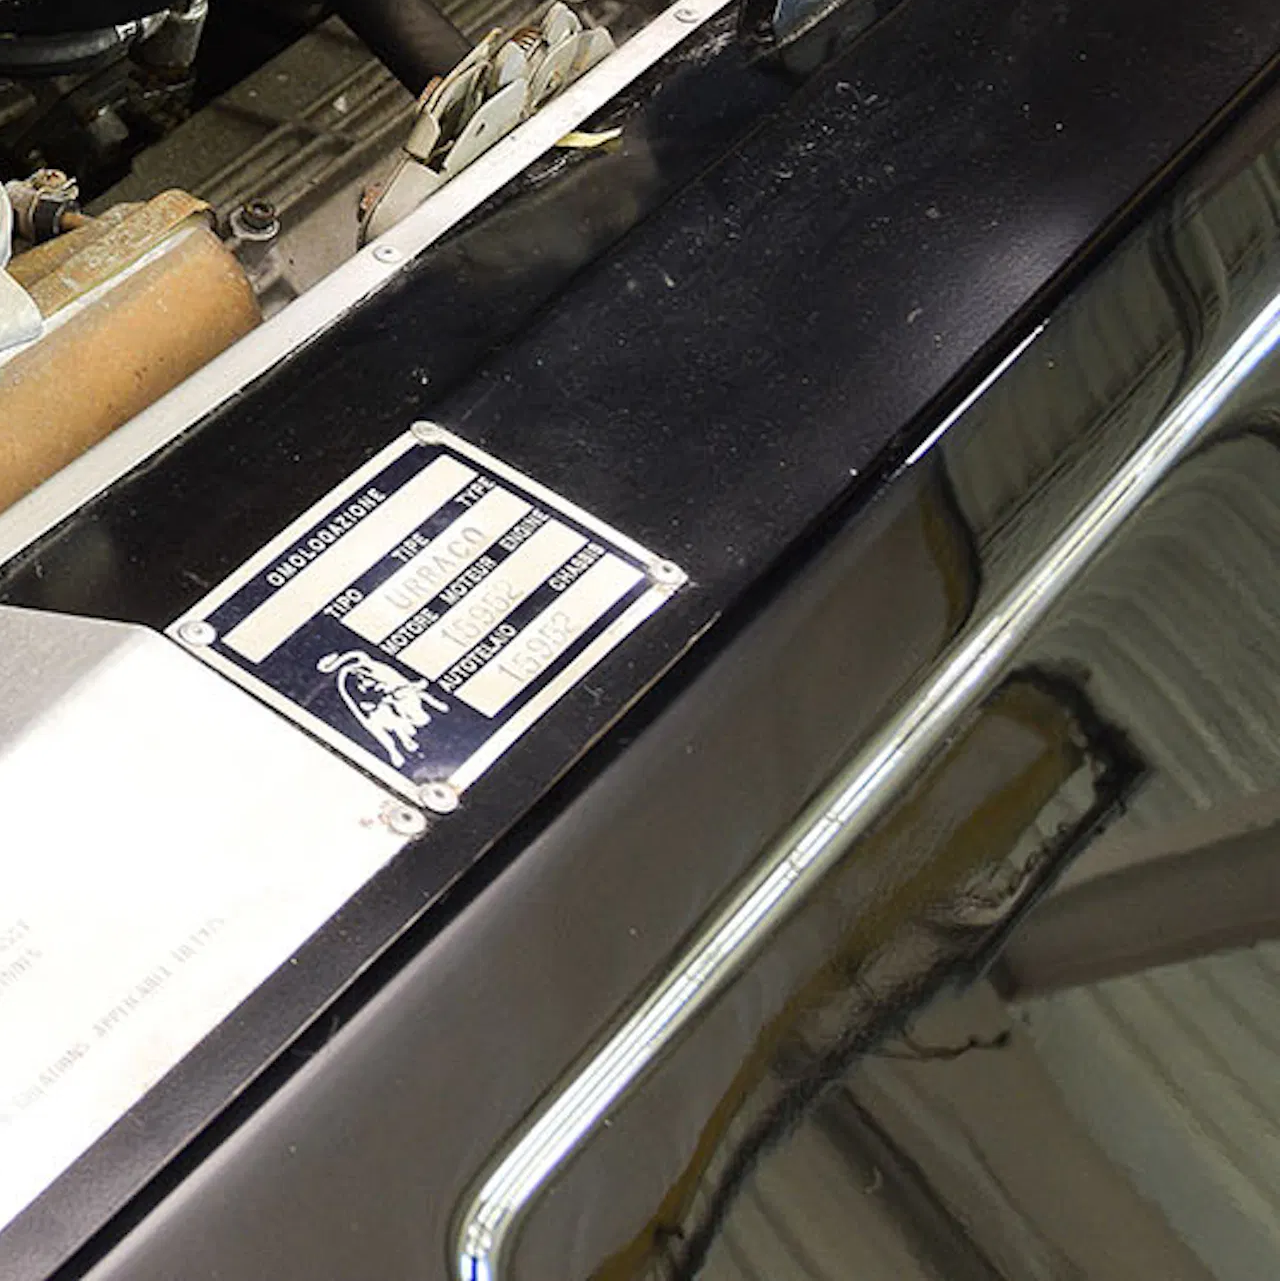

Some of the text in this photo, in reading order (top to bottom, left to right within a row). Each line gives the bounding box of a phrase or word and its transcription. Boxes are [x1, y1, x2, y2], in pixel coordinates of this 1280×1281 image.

[266, 487, 386, 587] OMOLOGAZIONE
[323, 587, 365, 619] TIPO
[454, 475, 496, 507] TYPE
[379, 507, 551, 655] MOTORE MOTEUR ENGINE
[384, 526, 486, 610] URRACO
[438, 540, 608, 692] AUTOTELAIO CHASSIS
